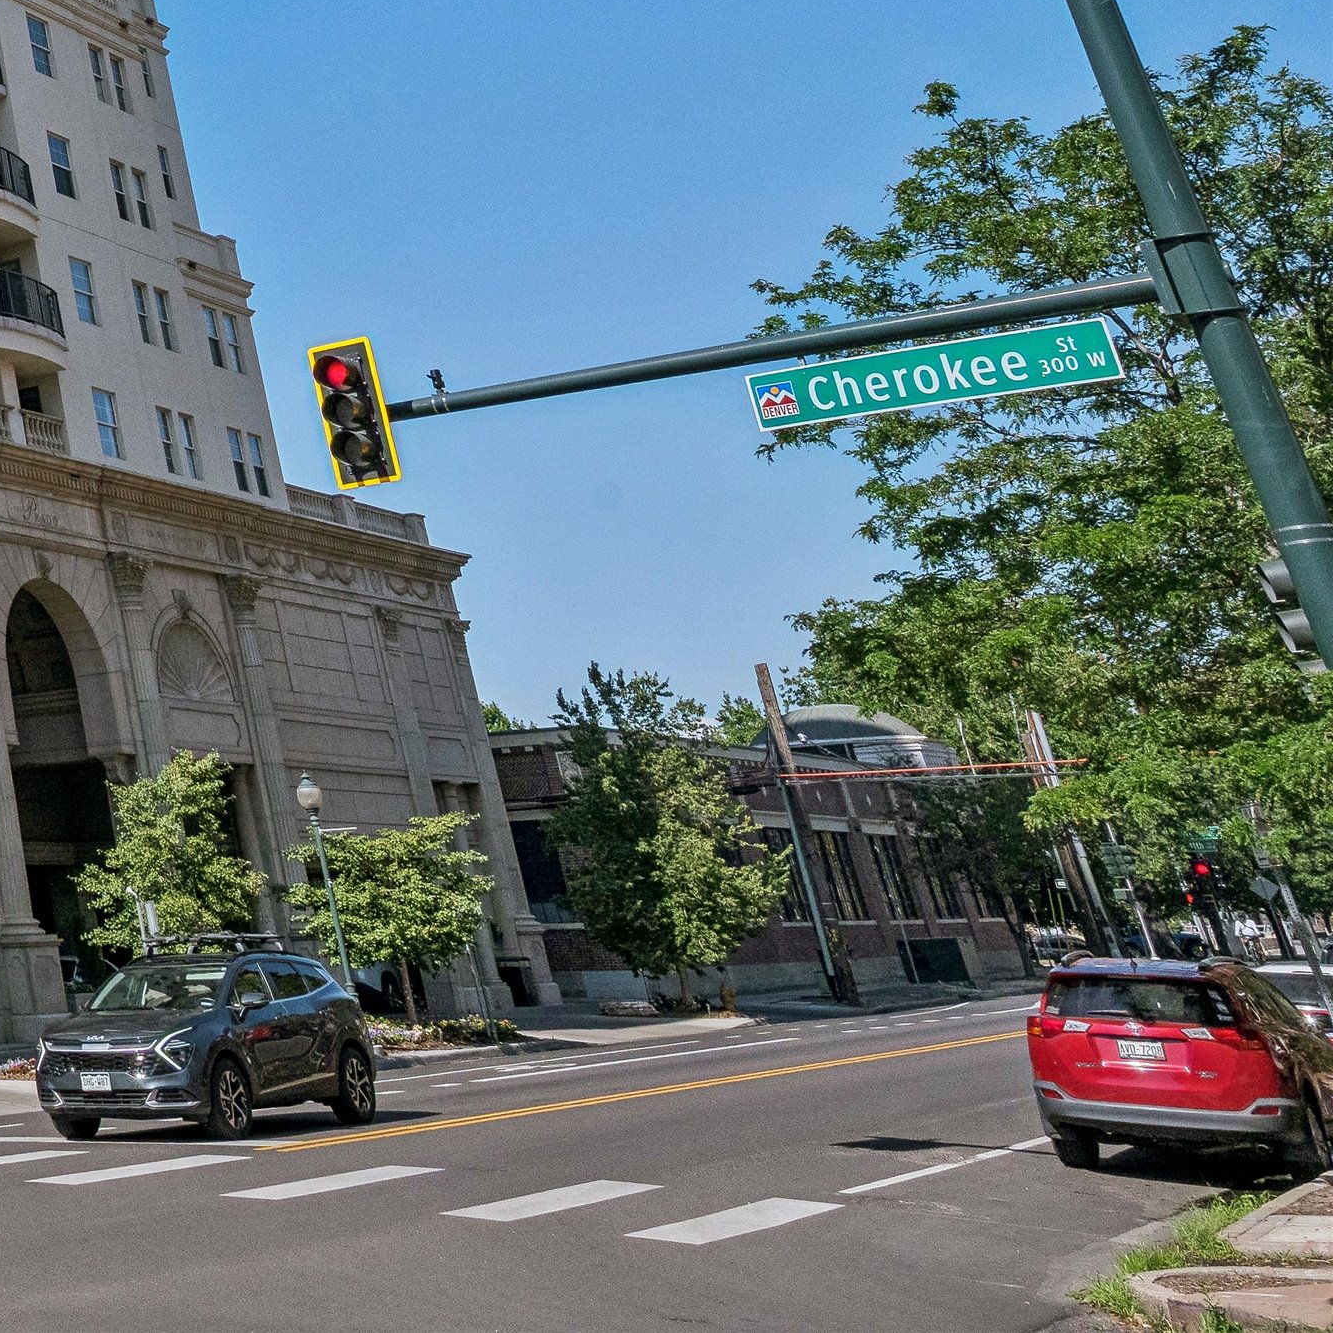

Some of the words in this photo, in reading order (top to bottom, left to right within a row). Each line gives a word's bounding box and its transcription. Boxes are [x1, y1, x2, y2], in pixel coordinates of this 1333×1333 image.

[1055, 335, 1078, 353] St
[1038, 355, 1079, 376] 300
[1086, 350, 1107, 368] W
[807, 350, 1029, 411] Cherokee
[762, 402, 799, 419] DENVER
